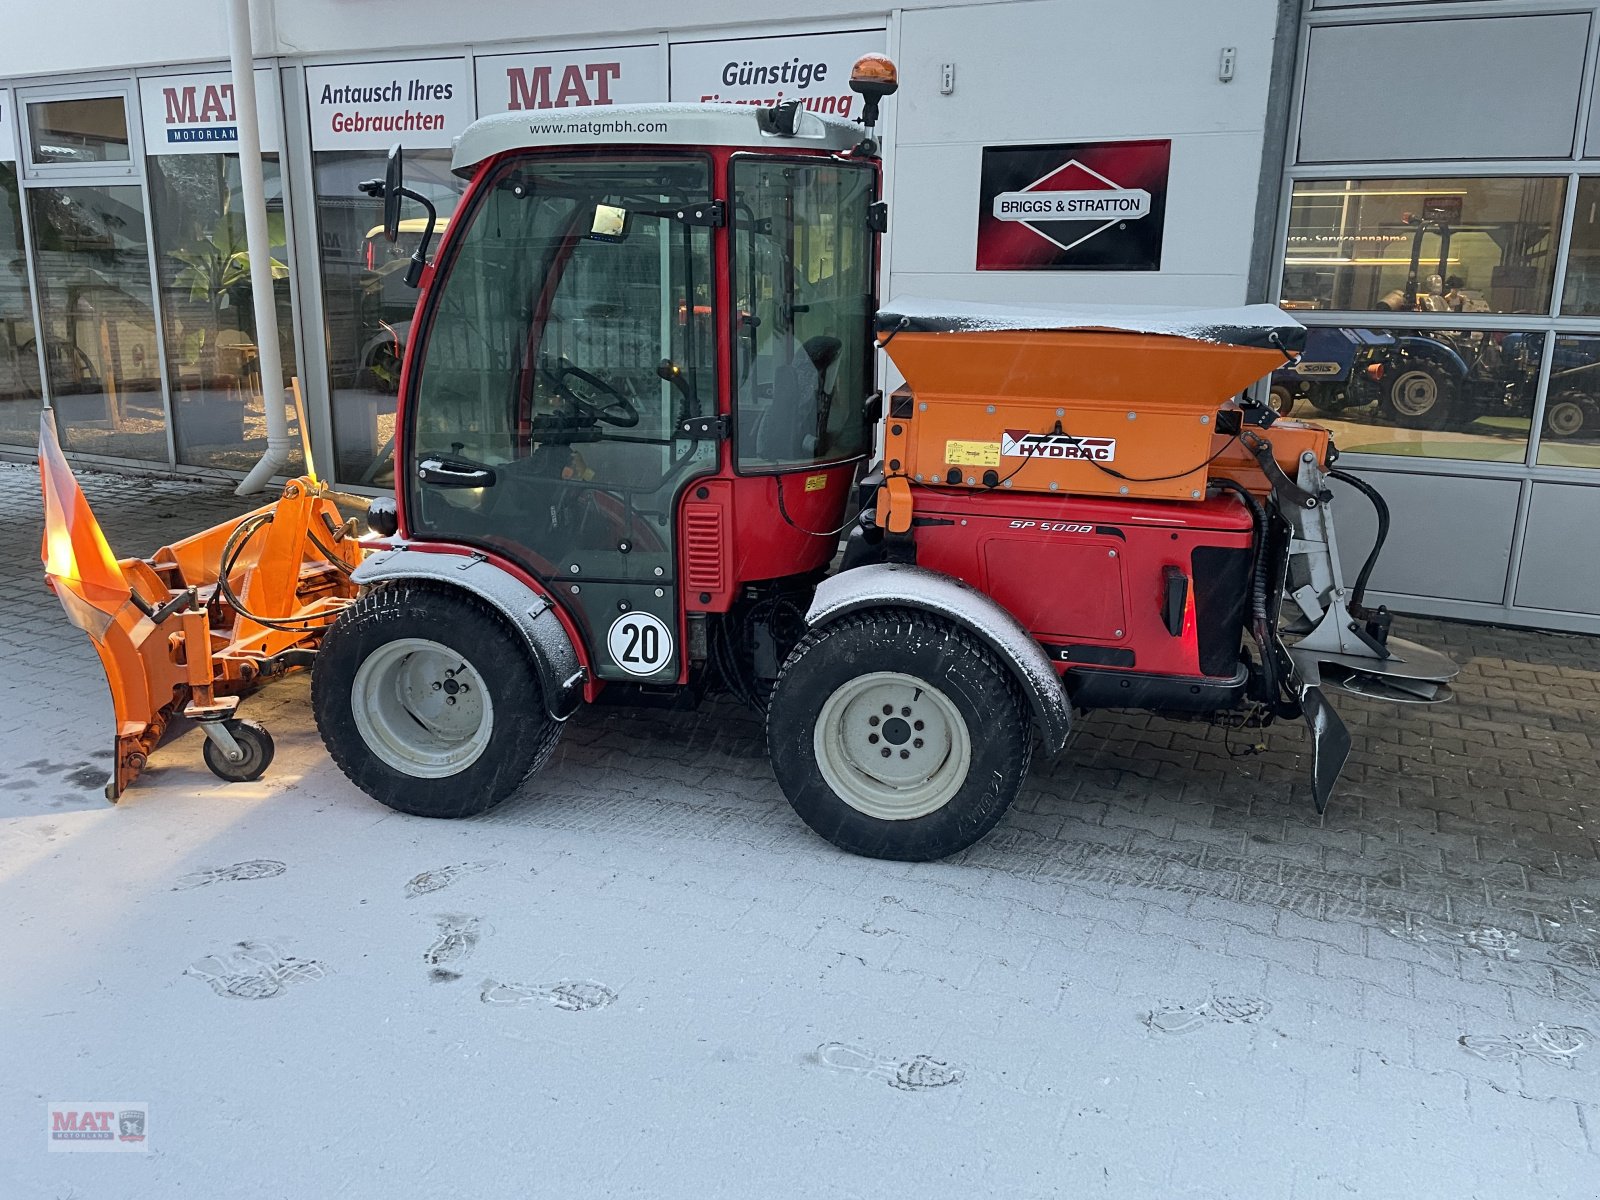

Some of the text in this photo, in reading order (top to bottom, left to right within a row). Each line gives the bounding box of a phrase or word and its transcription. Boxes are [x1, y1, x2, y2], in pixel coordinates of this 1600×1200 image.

[722, 57, 827, 89] Günstige
[320, 79, 453, 105] Antausch Ihres
[506, 62, 621, 110] MAT
[162, 84, 237, 124] MAT
[331, 109, 445, 133] Gebrauchten
[529, 121, 668, 136] www.matgmbh.com
[173, 129, 237, 141] MOTORLAN
[1001, 198, 1141, 213] BRIGGS & STRATTON
[1019, 443, 1109, 460] HYDRAC
[1009, 520, 1093, 533] SP 5008
[622, 623, 659, 664] 20
